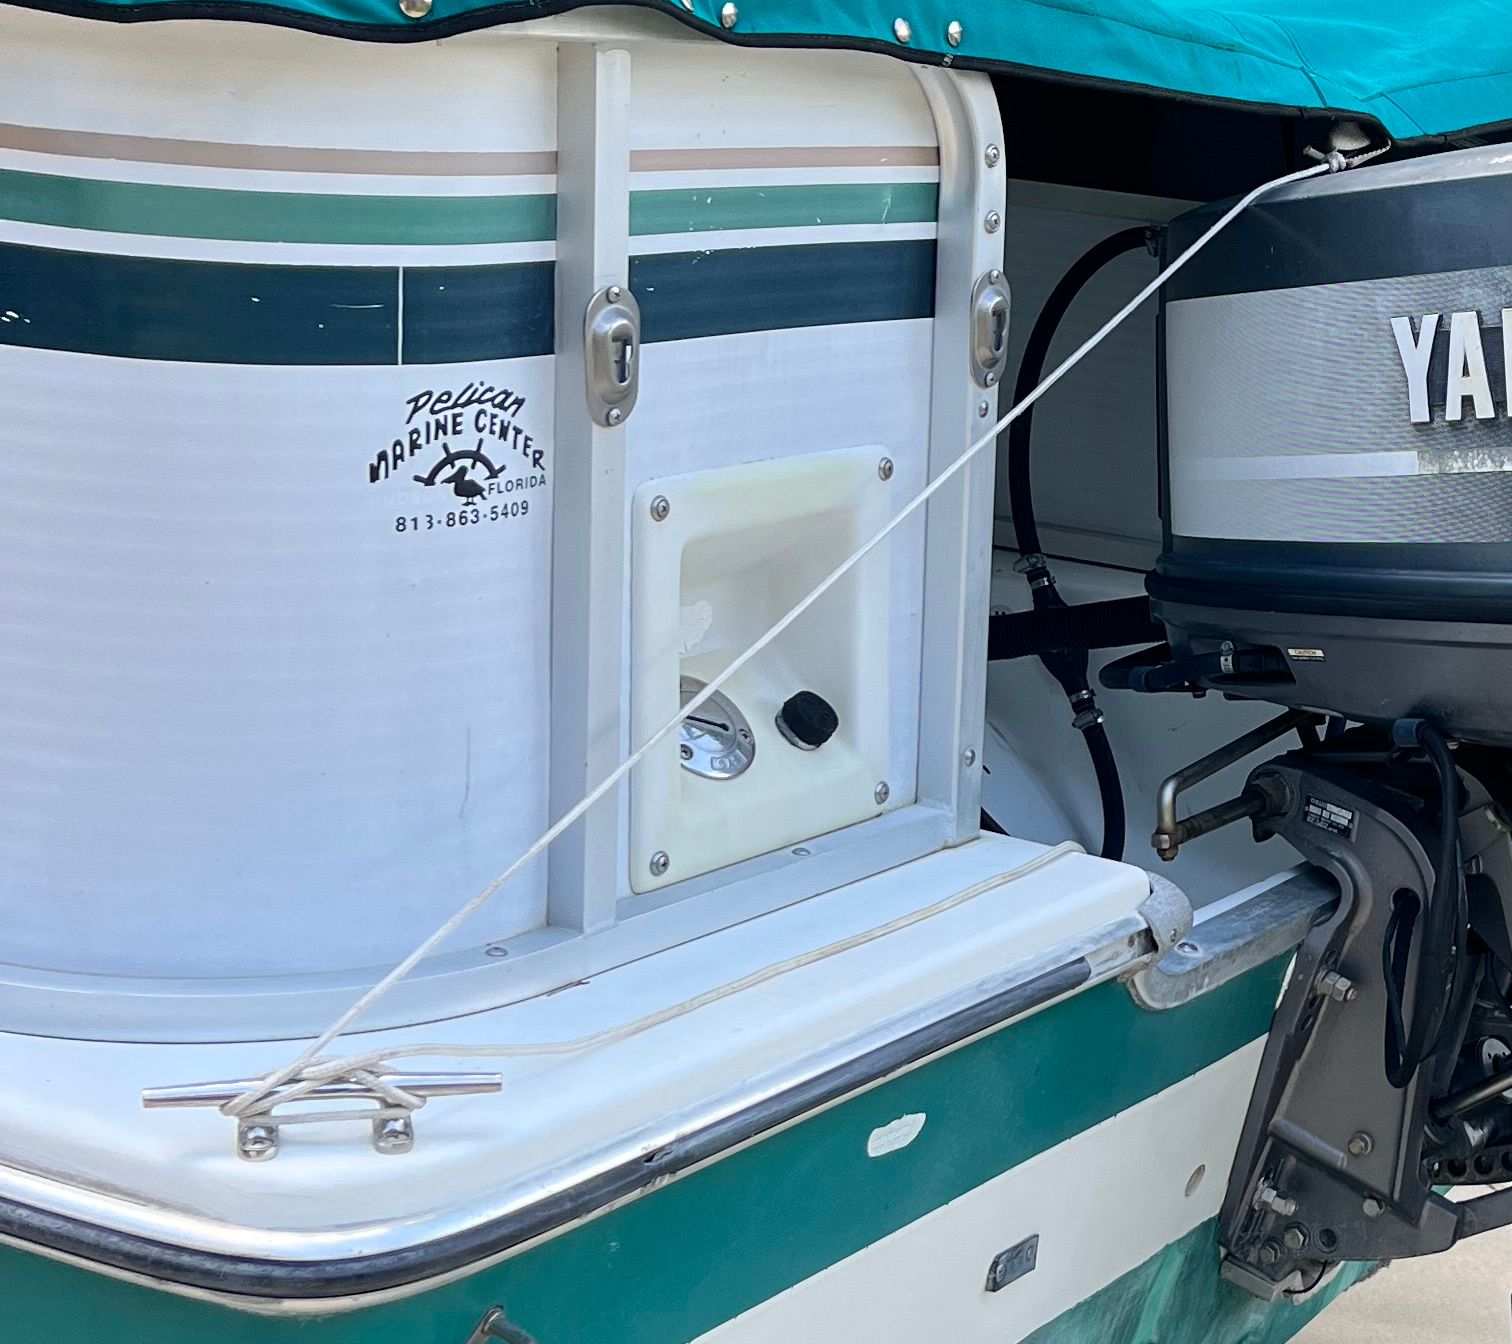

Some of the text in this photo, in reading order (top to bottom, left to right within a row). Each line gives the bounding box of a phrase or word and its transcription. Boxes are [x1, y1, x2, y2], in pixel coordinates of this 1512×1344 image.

[368, 408, 546, 484] MARINE CENTER
[487, 474, 547, 495] FLORIDA
